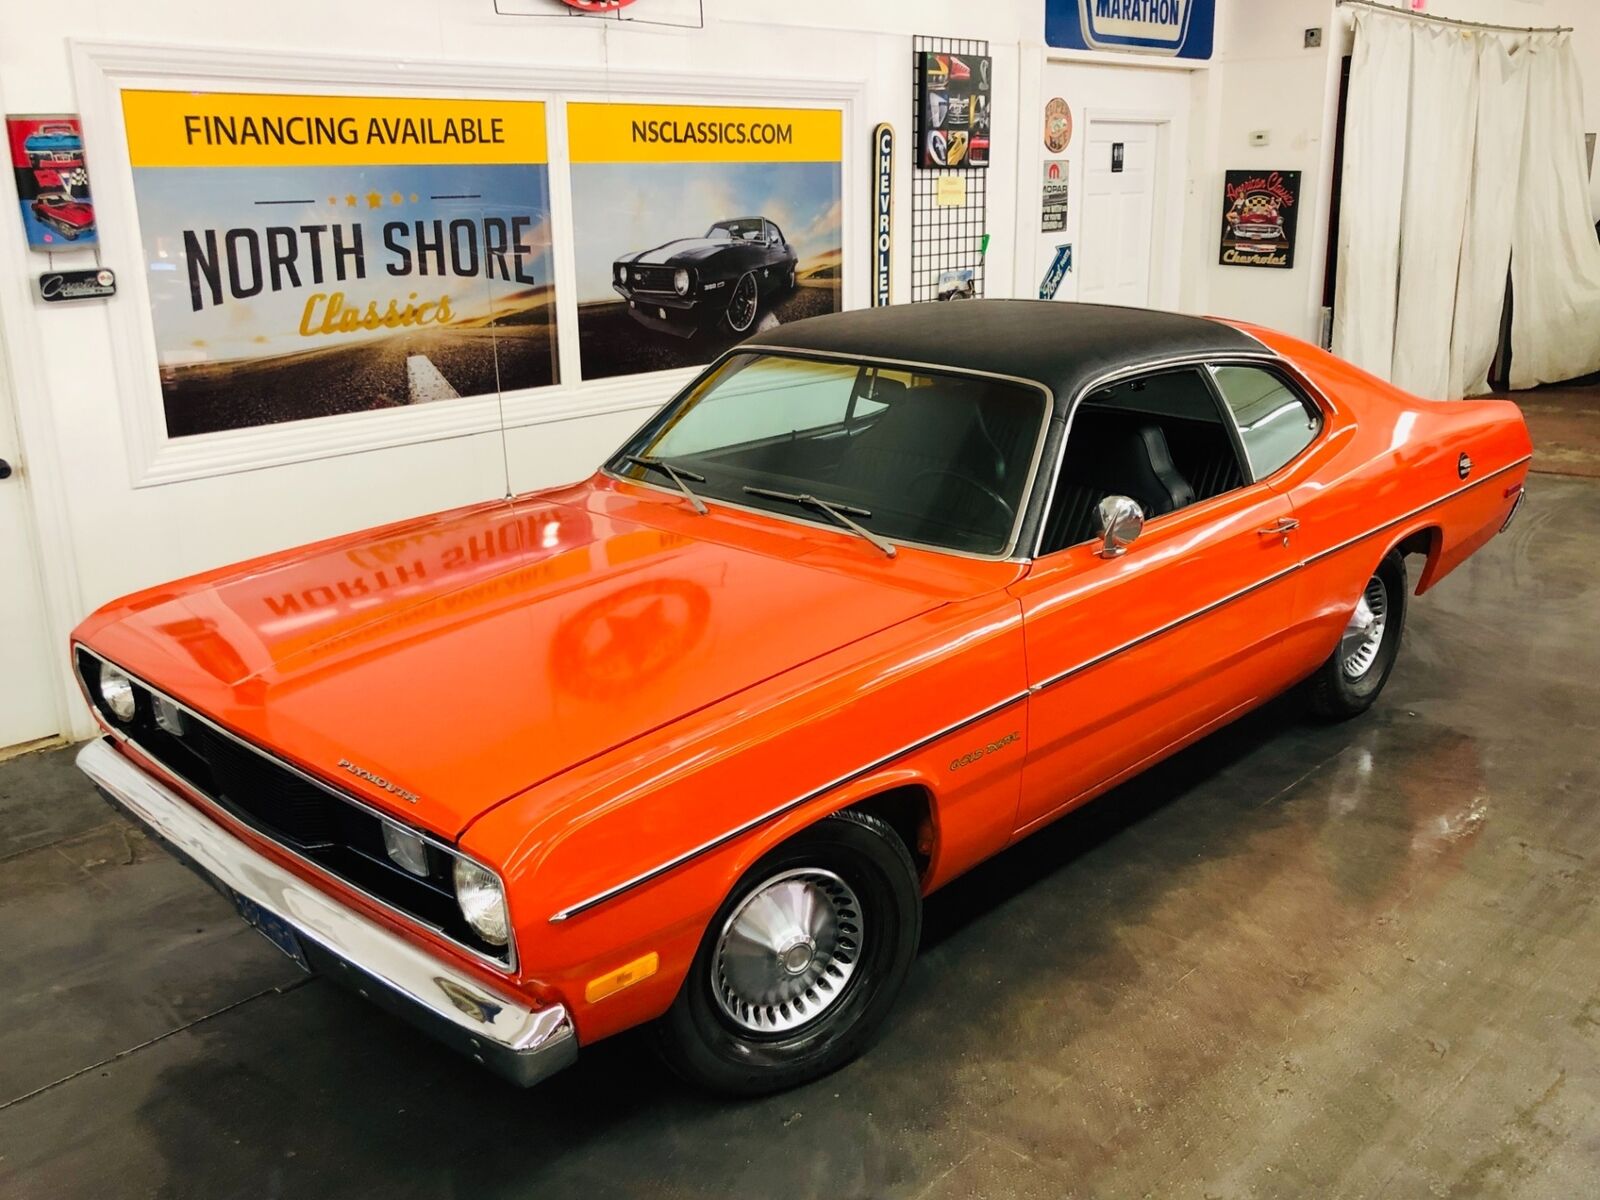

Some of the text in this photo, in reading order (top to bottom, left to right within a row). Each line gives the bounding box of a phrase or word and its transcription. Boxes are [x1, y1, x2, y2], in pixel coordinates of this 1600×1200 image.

[1096, 0, 1179, 25] MARATHON
[184, 115, 505, 145] FINANCING AVAILABLE
[632, 120, 793, 144] NSCLASSICS.COM
[878, 134, 892, 307] CHEVROLET
[183, 216, 535, 312] NORTH SHORE
[1223, 249, 1287, 265] Chevrolet
[299, 291, 456, 337] Classics
[337, 758, 420, 804] PLYMOUTH
